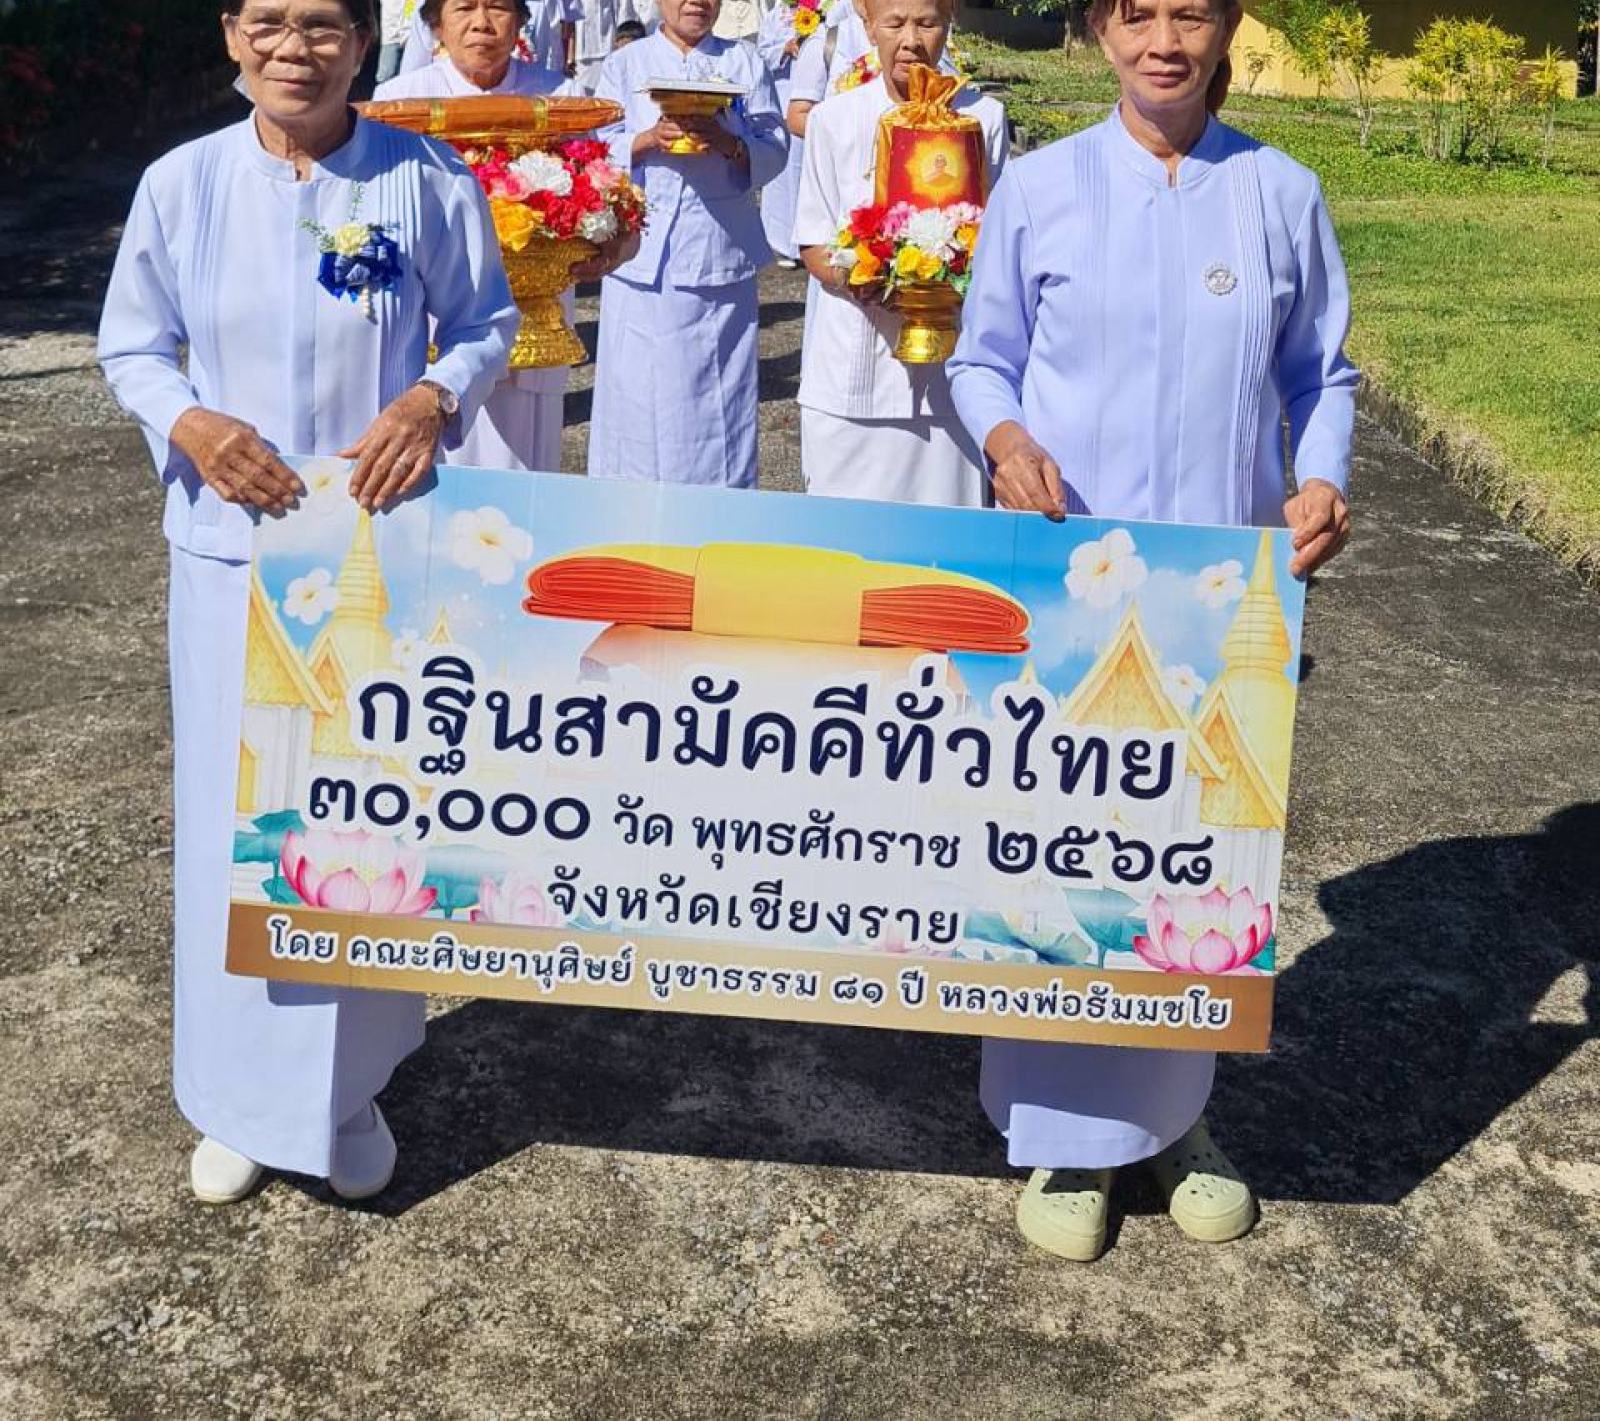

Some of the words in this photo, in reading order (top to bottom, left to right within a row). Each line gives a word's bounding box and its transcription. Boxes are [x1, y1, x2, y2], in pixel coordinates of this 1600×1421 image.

[359, 655, 1174, 800] กฐินสามัคคีทั่วไทย
[309, 777, 591, 841] ๓๐,๐๐๐
[614, 794, 673, 847] วัด
[692, 809, 961, 869] พุทธศักราช
[985, 820, 1214, 885] ๒๕๖๘
[547, 865, 959, 944] จังหวัดเชียงราย
[270, 919, 335, 959] โดย
[350, 936, 632, 989] คณะศิษยานุศิษย์
[647, 962, 816, 998] บูชาธรรม
[833, 977, 884, 1004] ๘๑
[900, 969, 925, 1005] ปี
[940, 982, 1229, 1026] หลวงพ่อธัมมชโย
